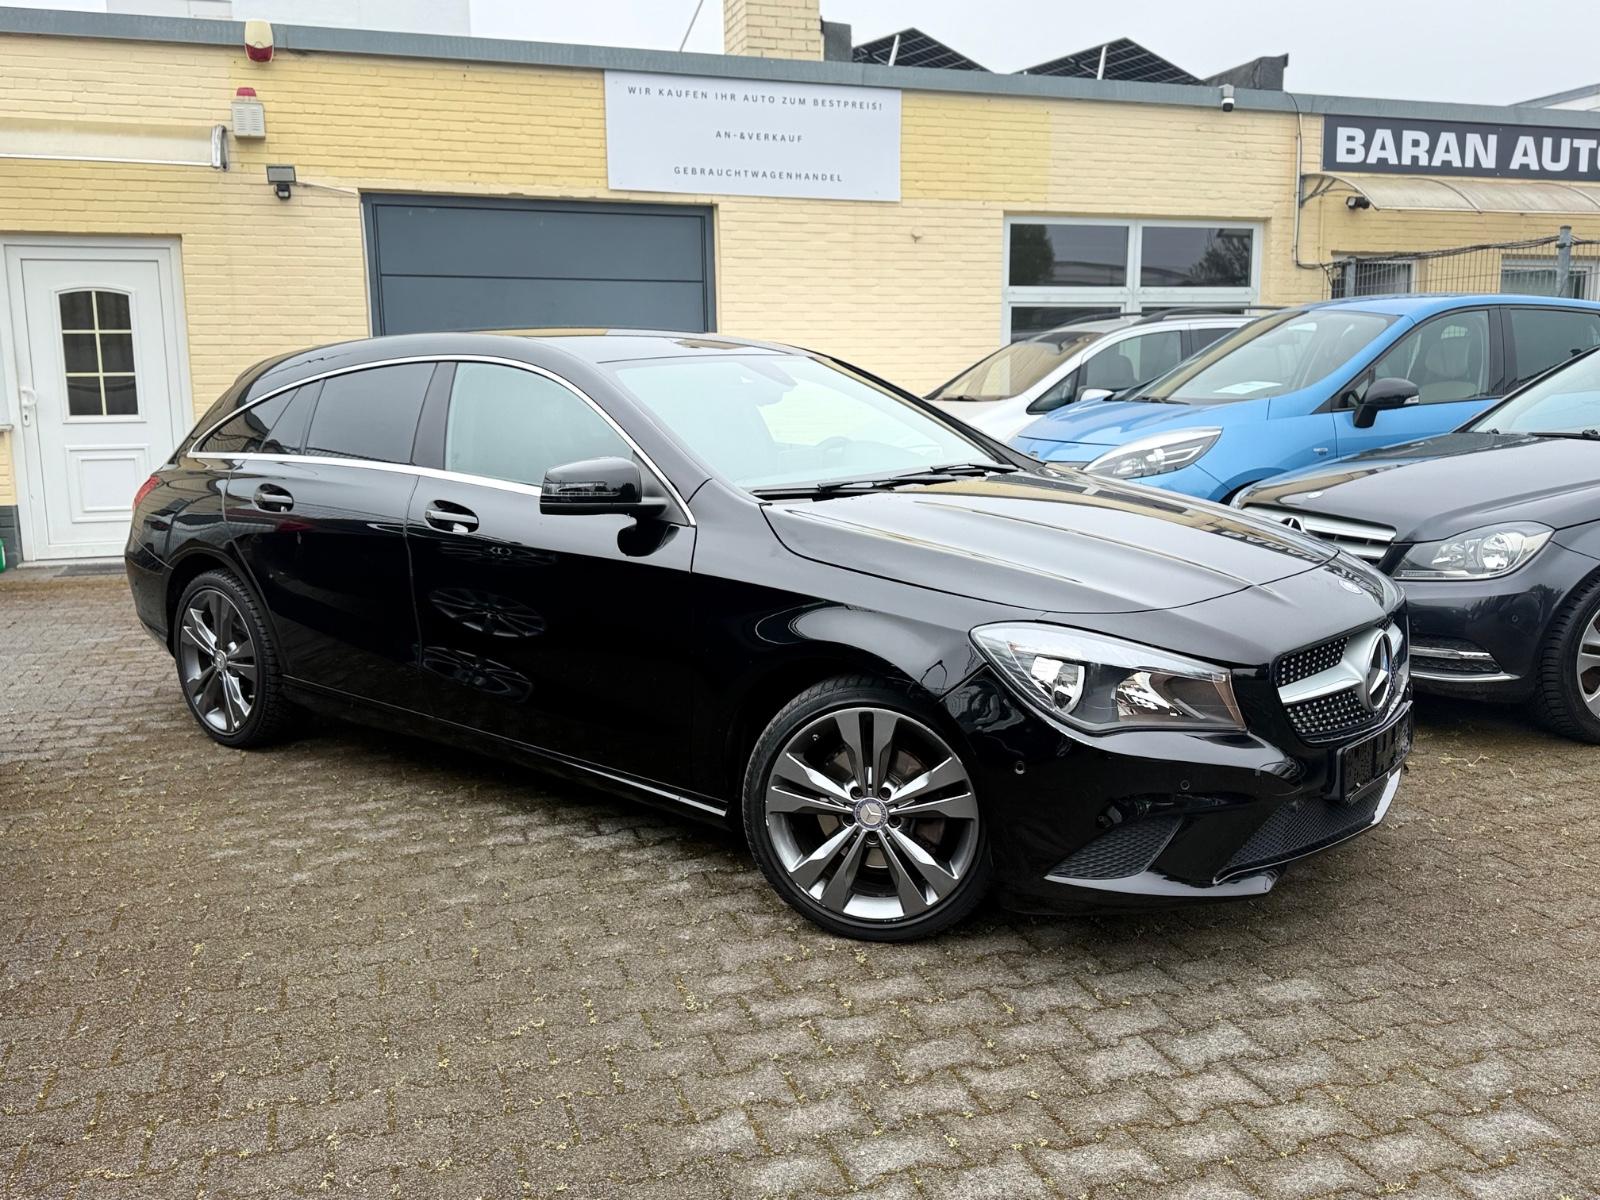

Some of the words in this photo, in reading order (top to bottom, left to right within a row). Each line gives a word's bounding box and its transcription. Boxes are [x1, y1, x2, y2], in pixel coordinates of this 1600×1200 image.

[627, 86, 652, 96] WIR
[658, 88, 708, 100] KAUFEN
[715, 92, 737, 102] IHR
[743, 94, 776, 105] AUTO
[782, 97, 807, 106] ZUM
[813, 98, 883, 111] BESTPREIS!
[715, 130, 803, 143] AN-&VERKAUF
[1336, 126, 1498, 169] BARAN
[1509, 135, 1600, 173] AUT
[673, 166, 843, 182] GEBRAUCHTWAGENHANDEL
